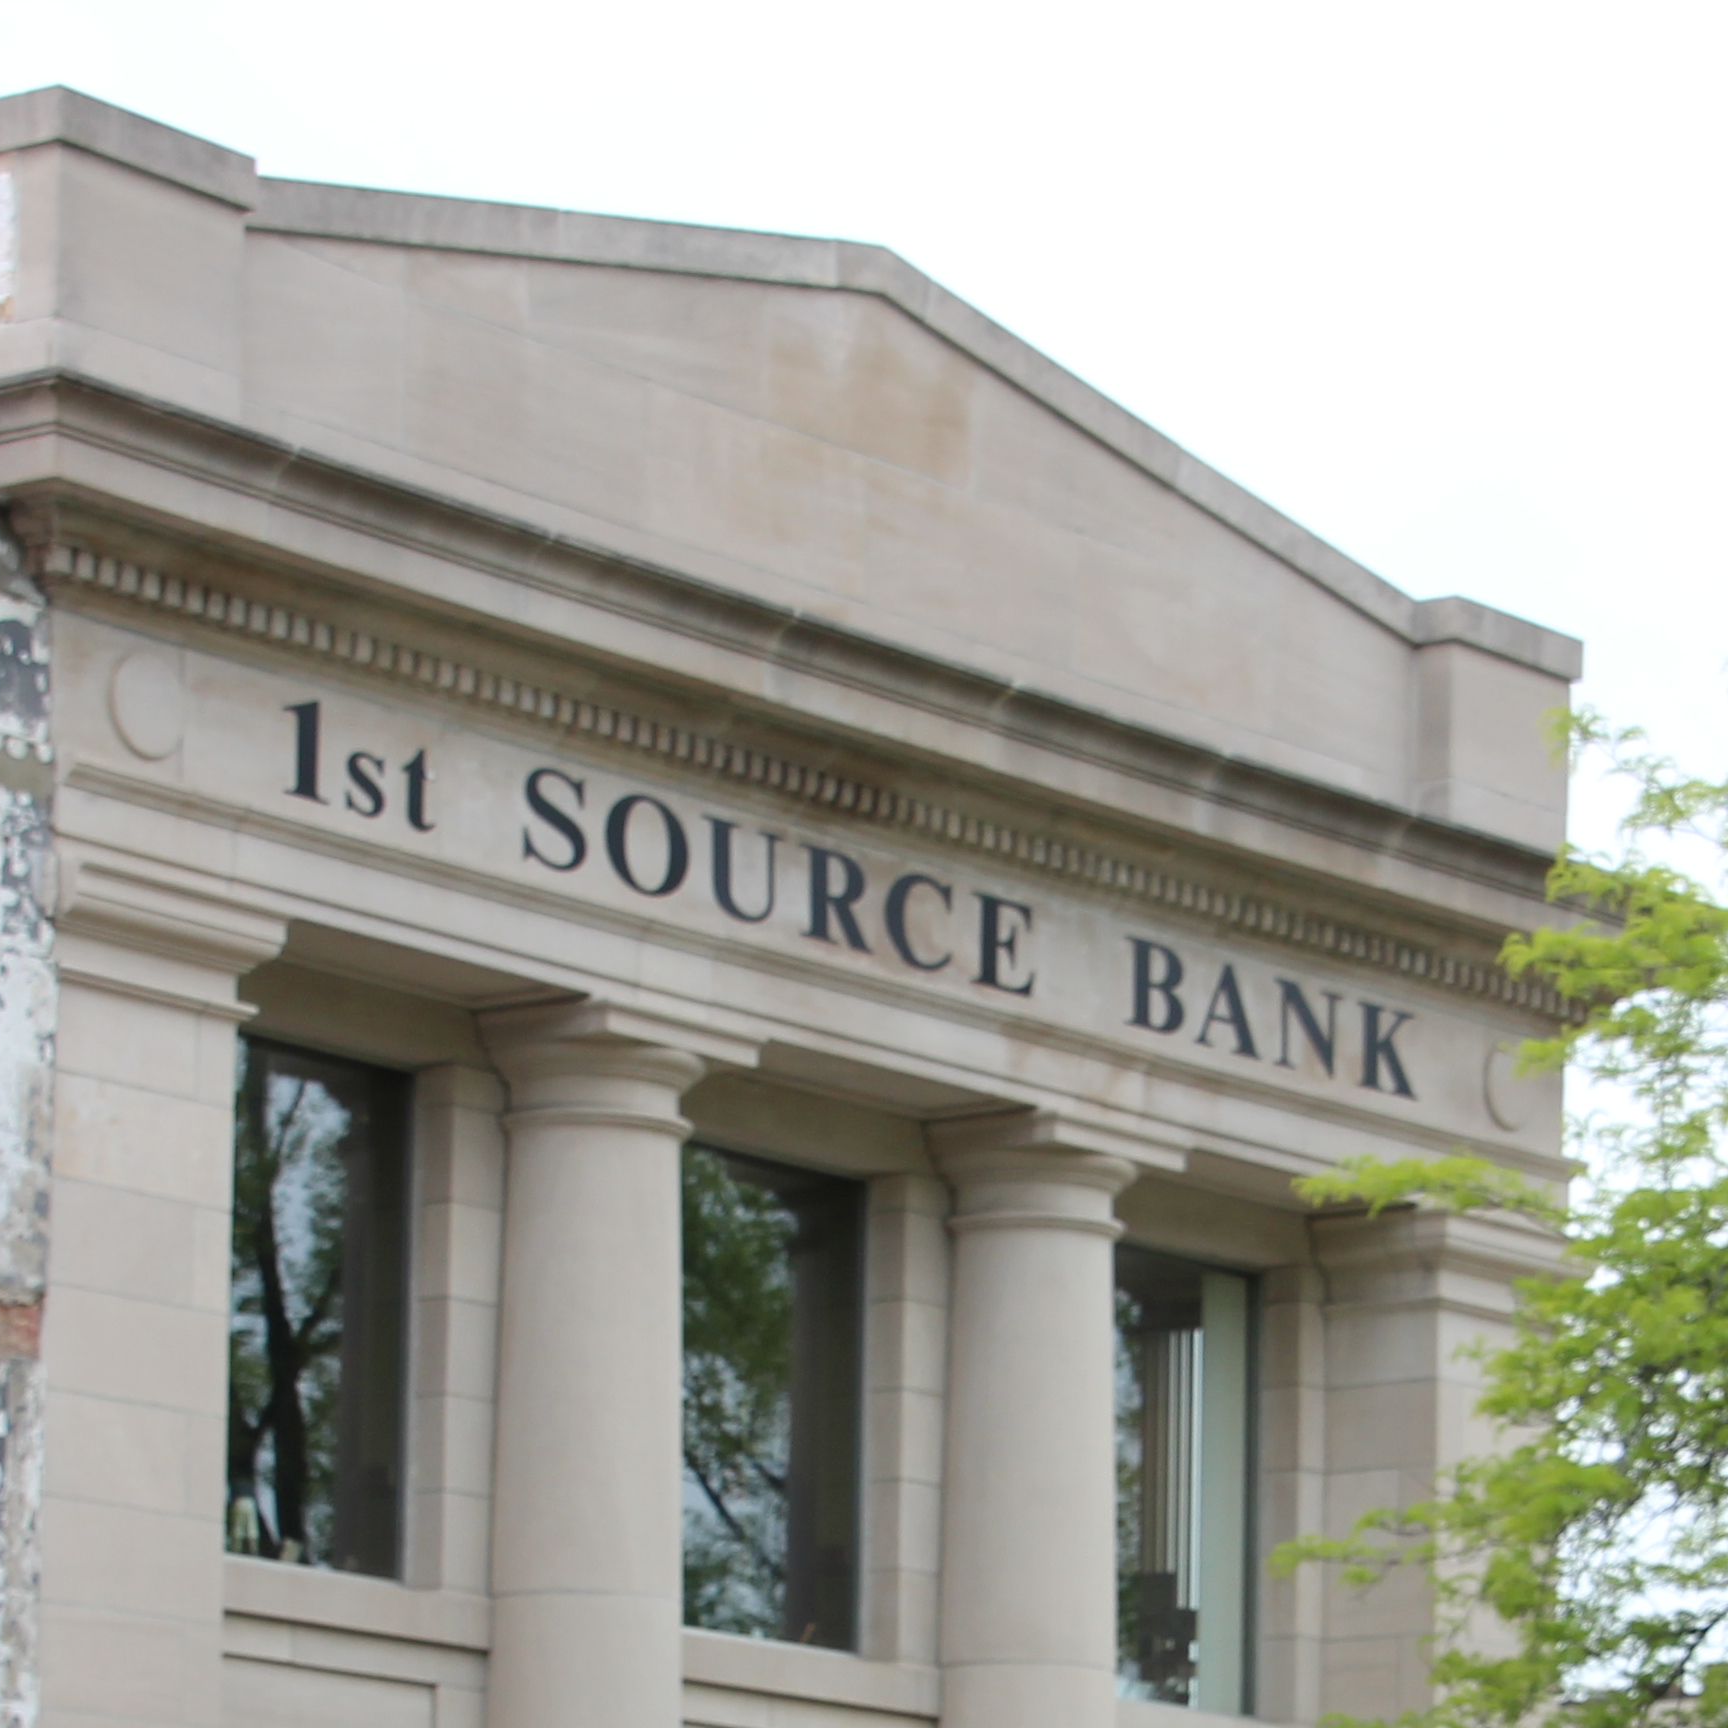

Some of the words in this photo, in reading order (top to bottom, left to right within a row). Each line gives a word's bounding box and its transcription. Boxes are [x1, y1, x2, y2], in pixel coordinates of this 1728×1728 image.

[283, 701, 438, 831] 1st
[522, 767, 1038, 997] SOURCE
[1125, 933, 1418, 1101] BANK
